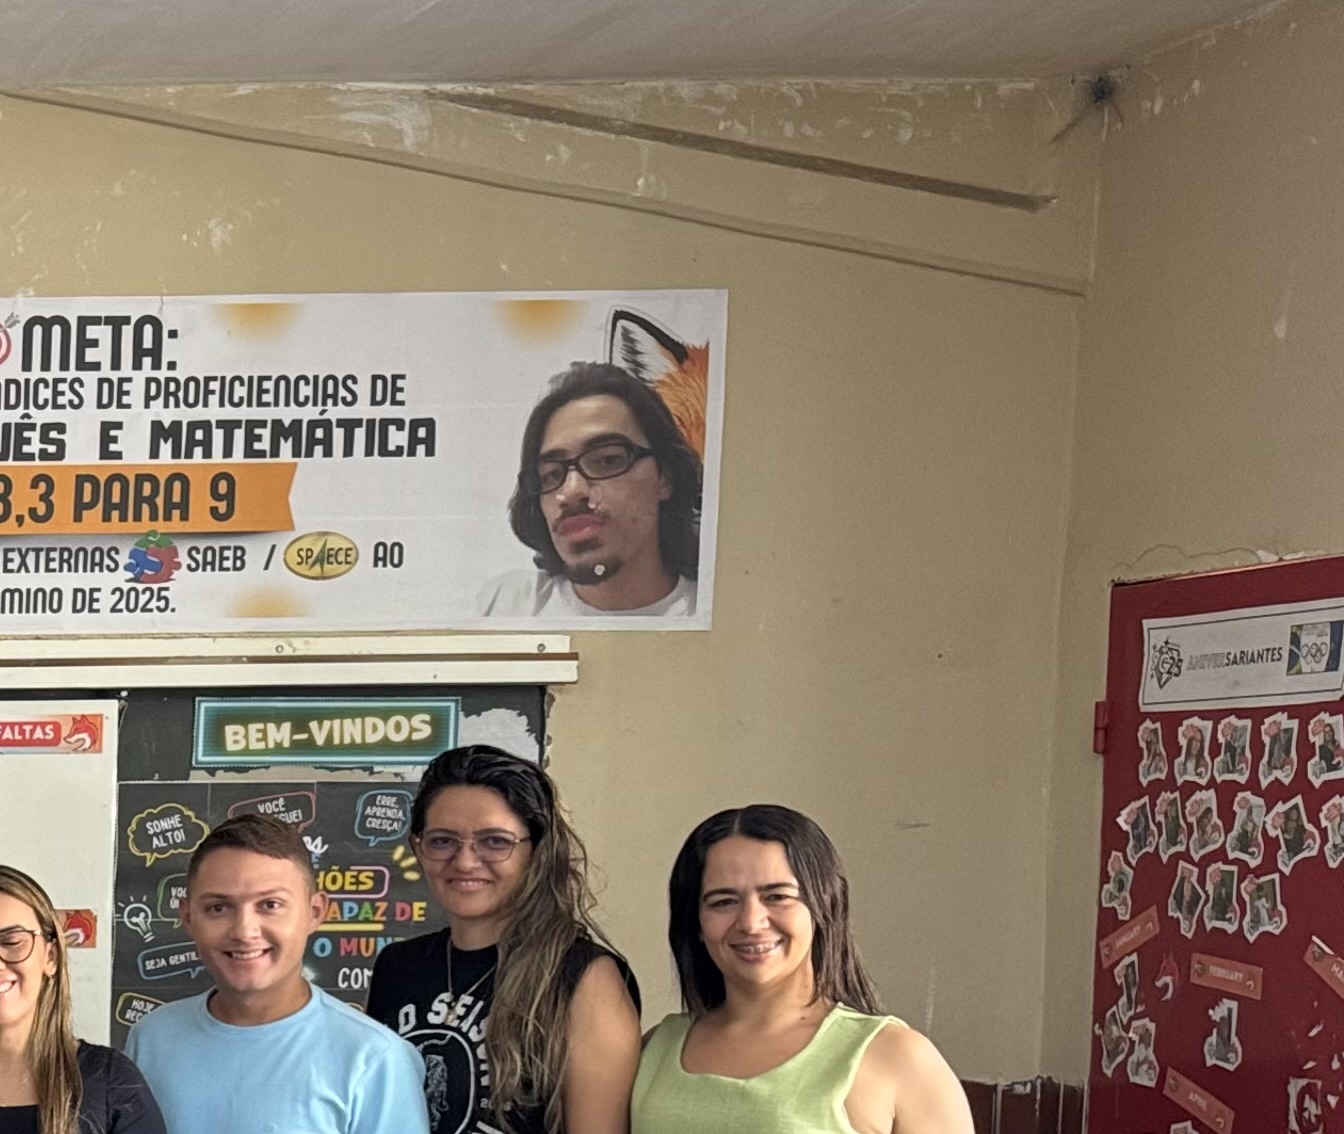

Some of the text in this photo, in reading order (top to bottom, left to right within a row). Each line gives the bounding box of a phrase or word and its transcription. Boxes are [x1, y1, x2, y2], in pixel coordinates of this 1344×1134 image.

[21, 315, 178, 372] META:
[96, 377, 133, 409] DE
[144, 374, 359, 409] PROFICIENCIAS
[369, 374, 406, 406] DE
[99, 420, 124, 460] E
[149, 409, 436, 460] MATEMÁTICA
[73, 472, 191, 522] PARA
[209, 471, 236, 522] 9
[2, 546, 120, 573] EXTERNAS
[186, 545, 246, 572] SAEB
[263, 544, 277, 571] /
[373, 541, 404, 568] AO
[72, 588, 101, 613] DE
[110, 587, 176, 614] 2025.
[224, 713, 433, 752] BEM-VINDOS
[258, 797, 286, 815] VOCÊ
[145, 814, 182, 835] SONHE
[326, 902, 427, 921] APAZ DE
[145, 954, 167, 971] SEJA
